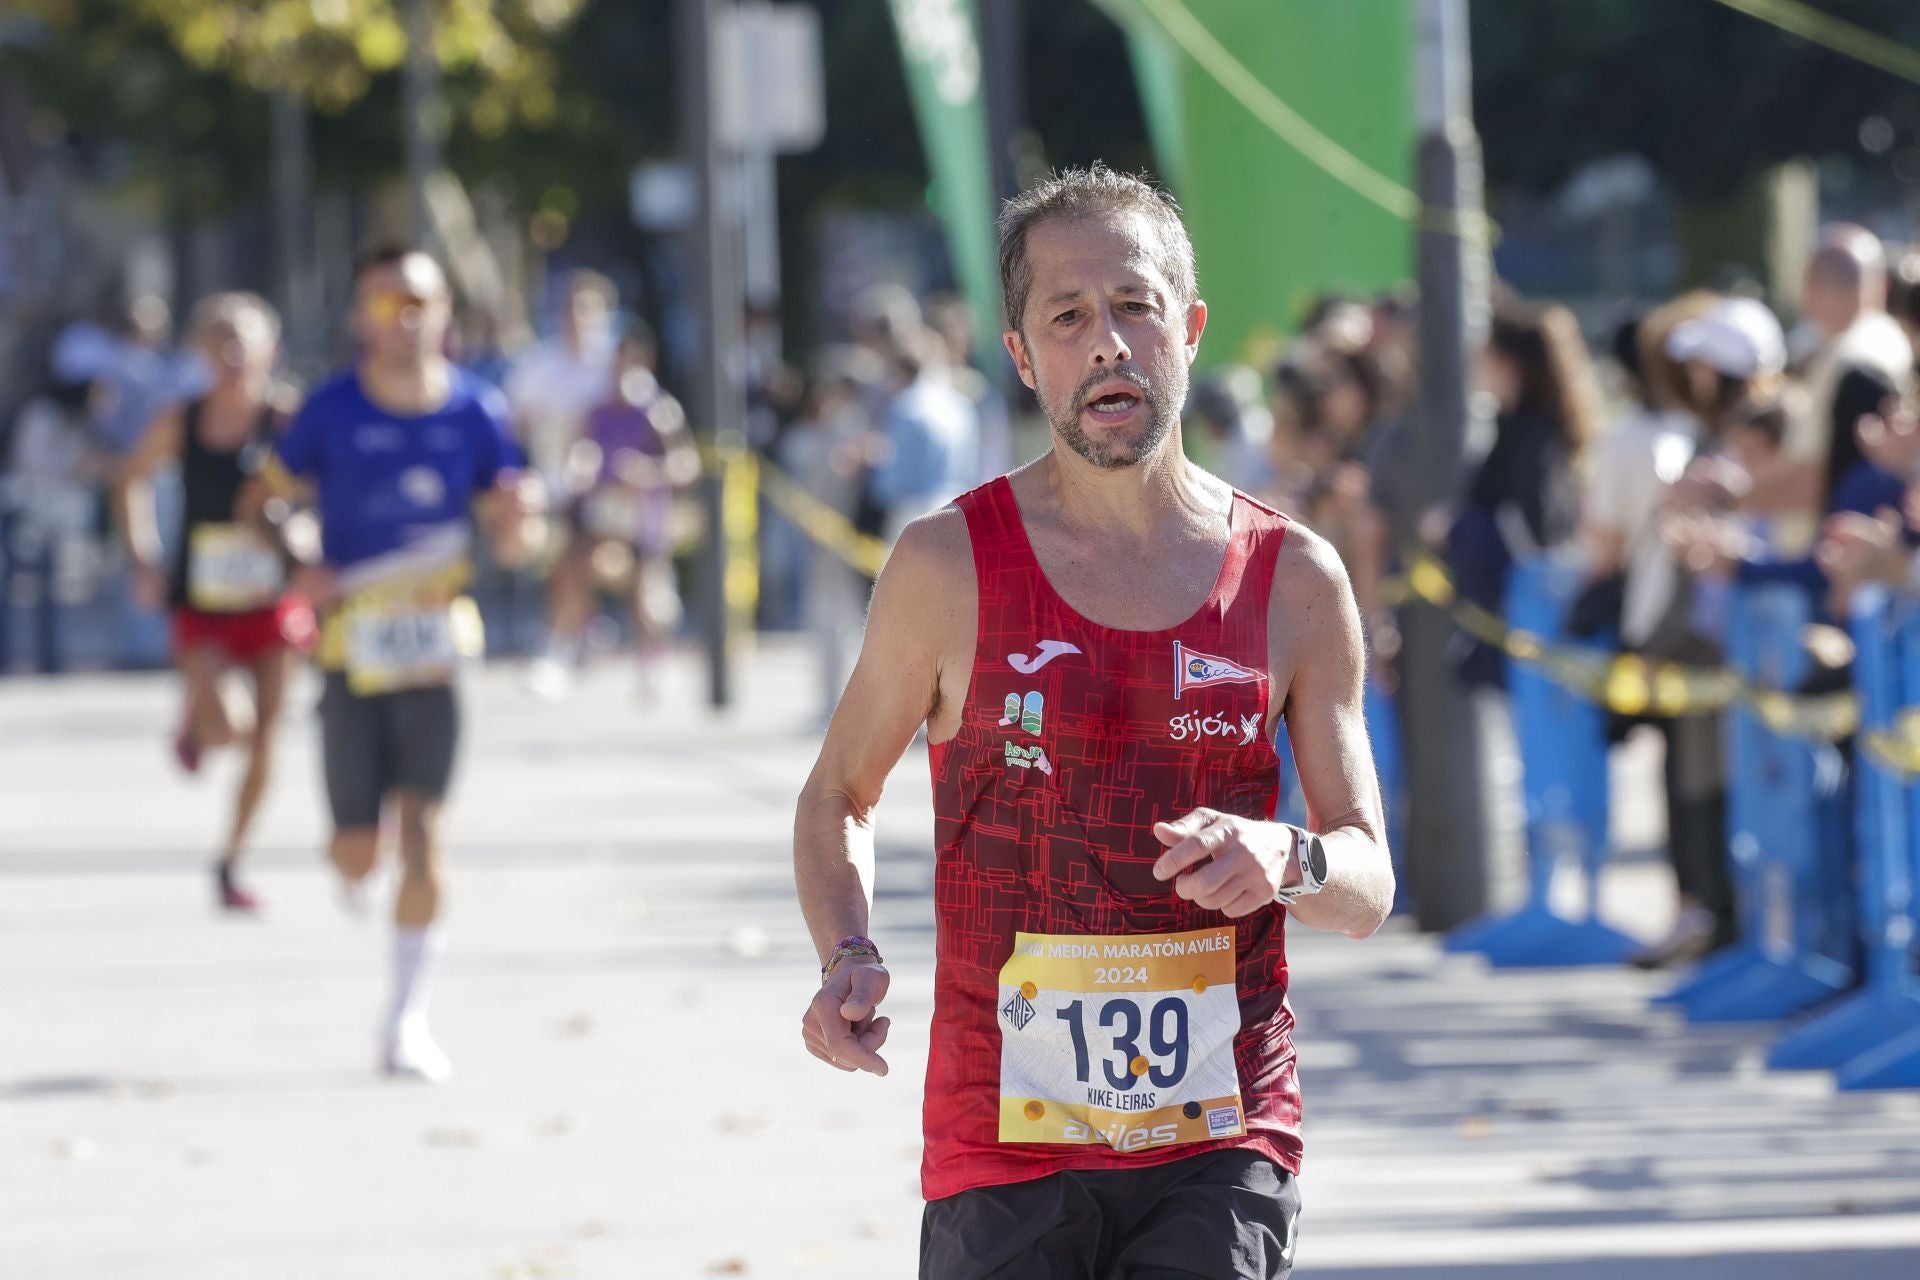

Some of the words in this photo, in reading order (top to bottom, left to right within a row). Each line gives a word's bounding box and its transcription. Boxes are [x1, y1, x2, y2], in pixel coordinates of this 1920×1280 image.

[1169, 709, 1237, 742] gijón
[1048, 943, 1100, 960] MEDIA
[1103, 938, 1185, 958] MARATÓN
[1187, 933, 1231, 955] AVILÉS
[1094, 966, 1149, 985] 2024
[1056, 996, 1189, 1091] 139
[1087, 1087, 1113, 1109] KIKE
[1116, 1092, 1156, 1111] LEIRAS
